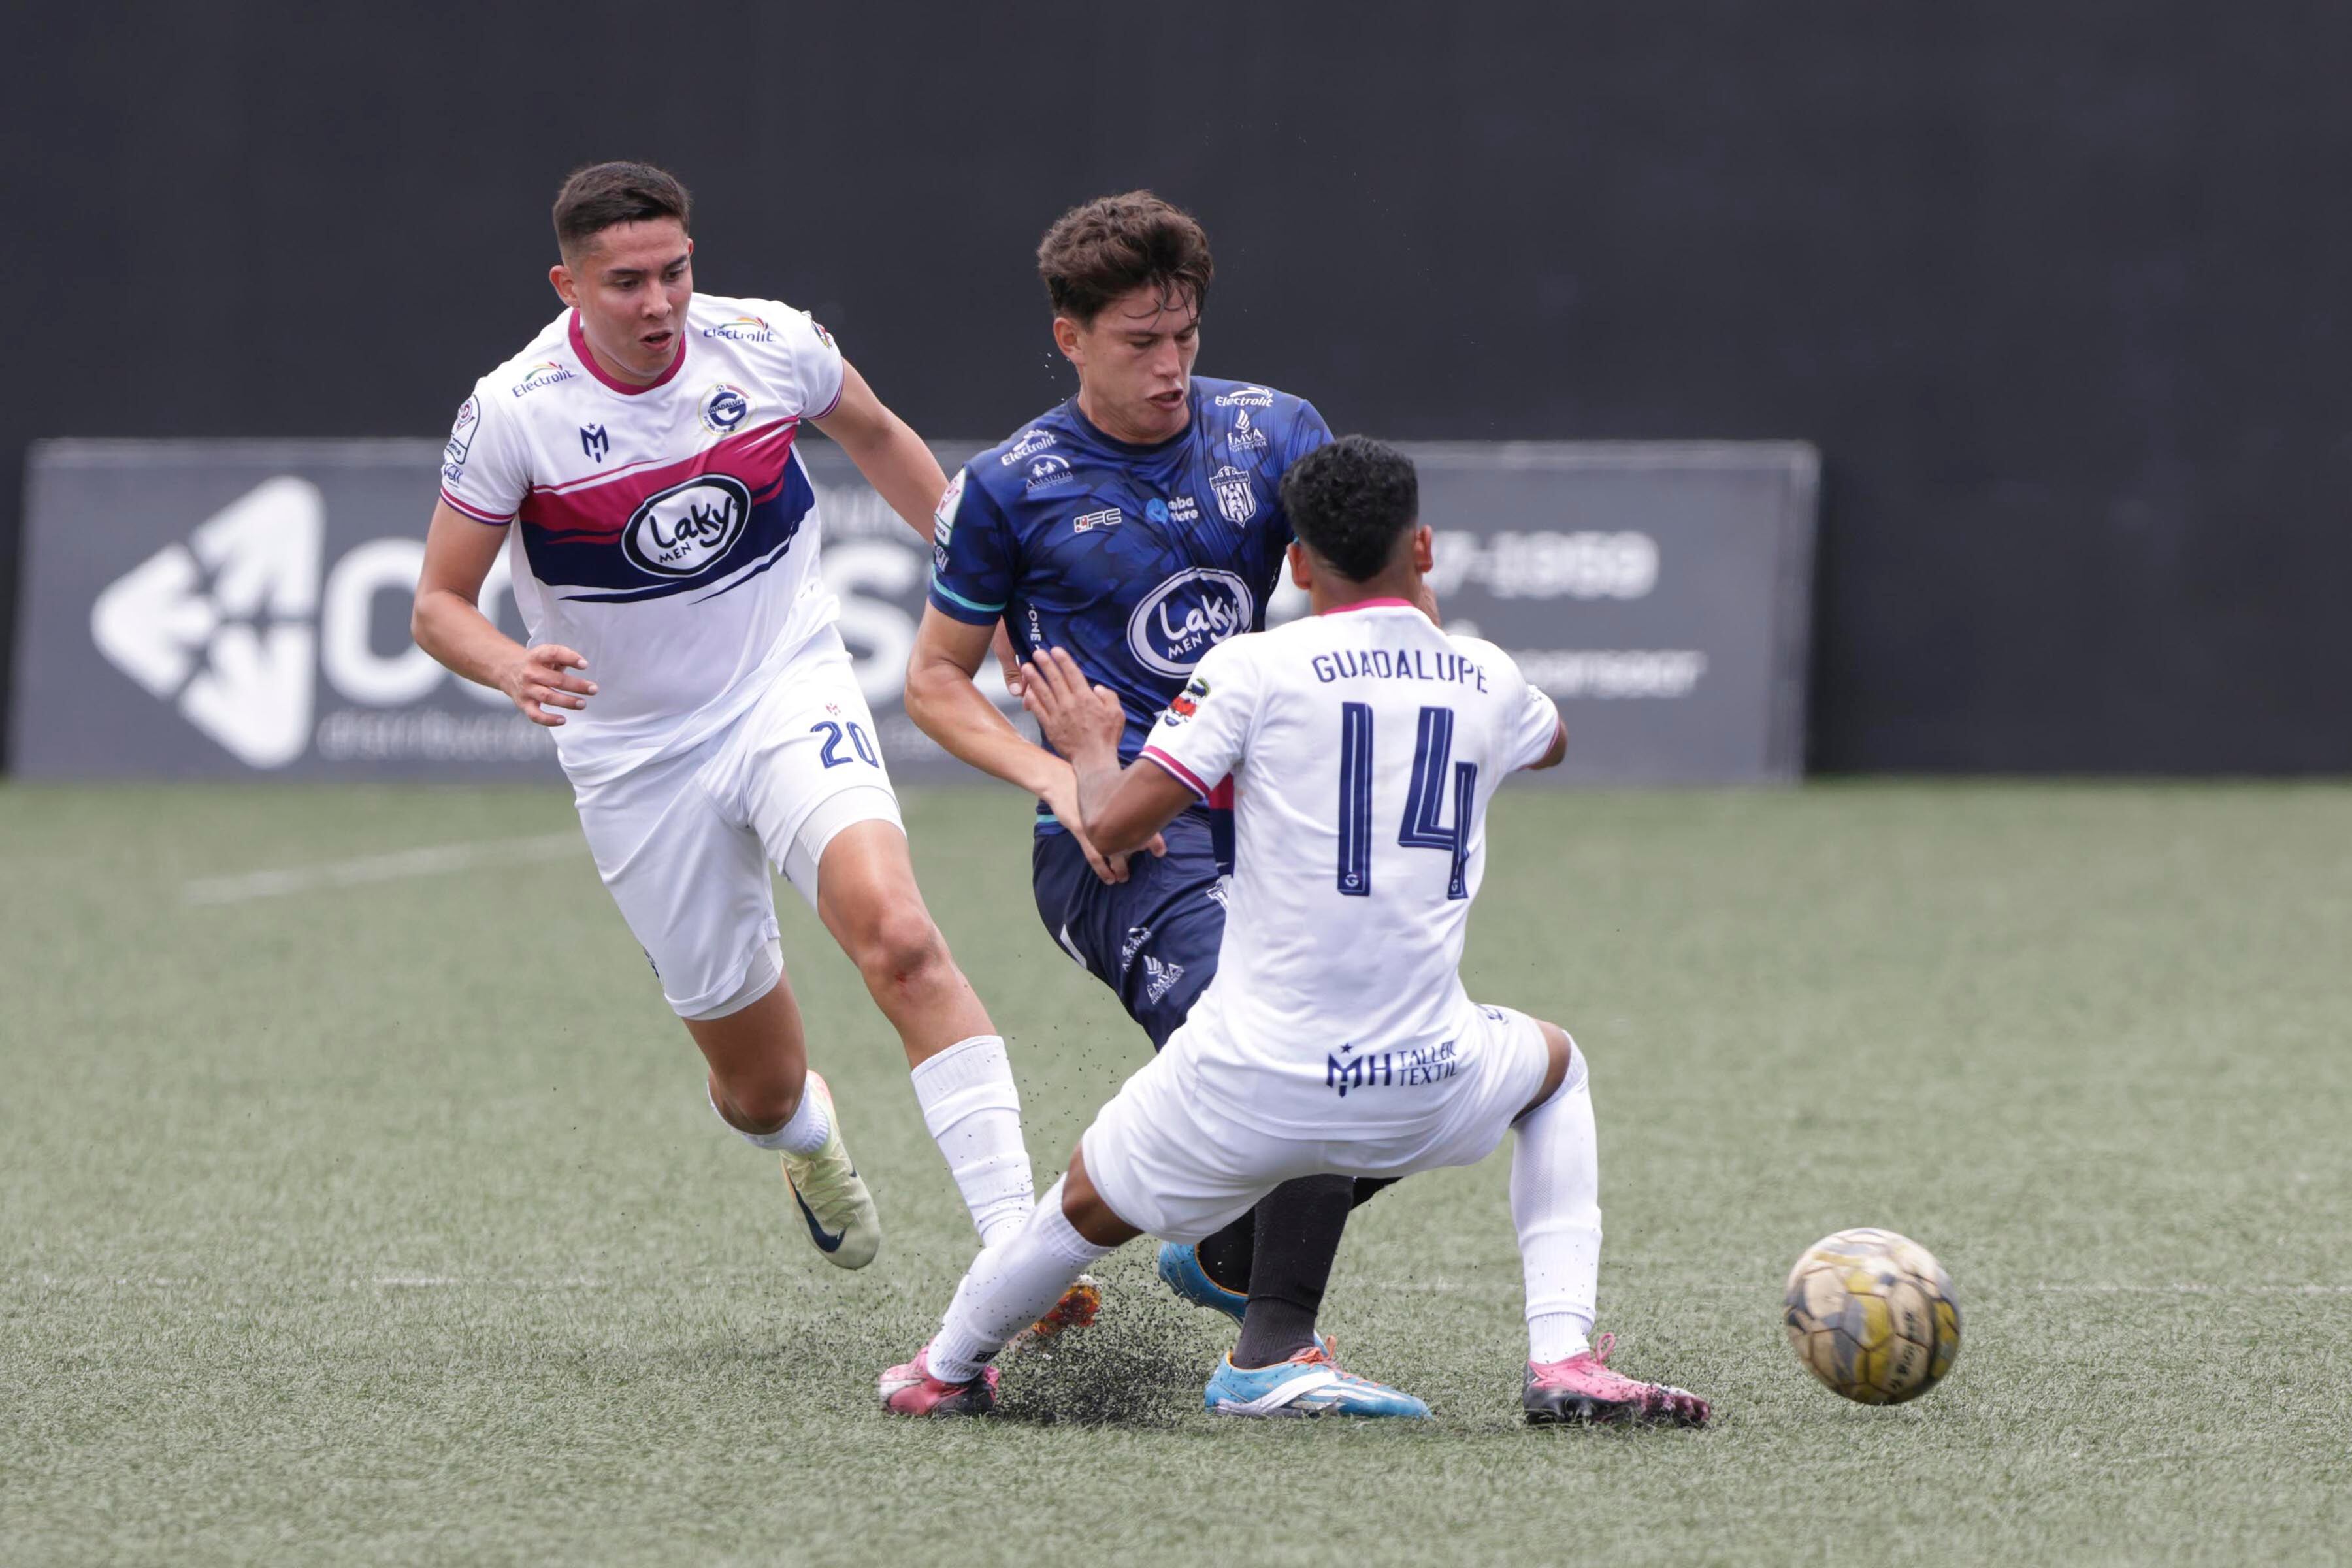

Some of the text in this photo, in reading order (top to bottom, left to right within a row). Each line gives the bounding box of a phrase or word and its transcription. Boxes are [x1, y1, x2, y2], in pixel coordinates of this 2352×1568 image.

[512, 370, 576, 397] Electrolit
[1215, 395, 1273, 407] Electrolit
[1001, 434, 1057, 466] Electrolit
[649, 497, 732, 549] Laky
[659, 542, 692, 563] MEN
[1028, 603, 1041, 641] ONE
[1160, 595, 1238, 644] Laky
[1168, 632, 1203, 659] MEN
[1311, 649, 1488, 694] GUADALUPE
[810, 721, 879, 769] 20
[1337, 702, 1477, 900] 14
[1397, 1040, 1456, 1066] TALLER
[1398, 1061, 1458, 1086] TEXTIL
